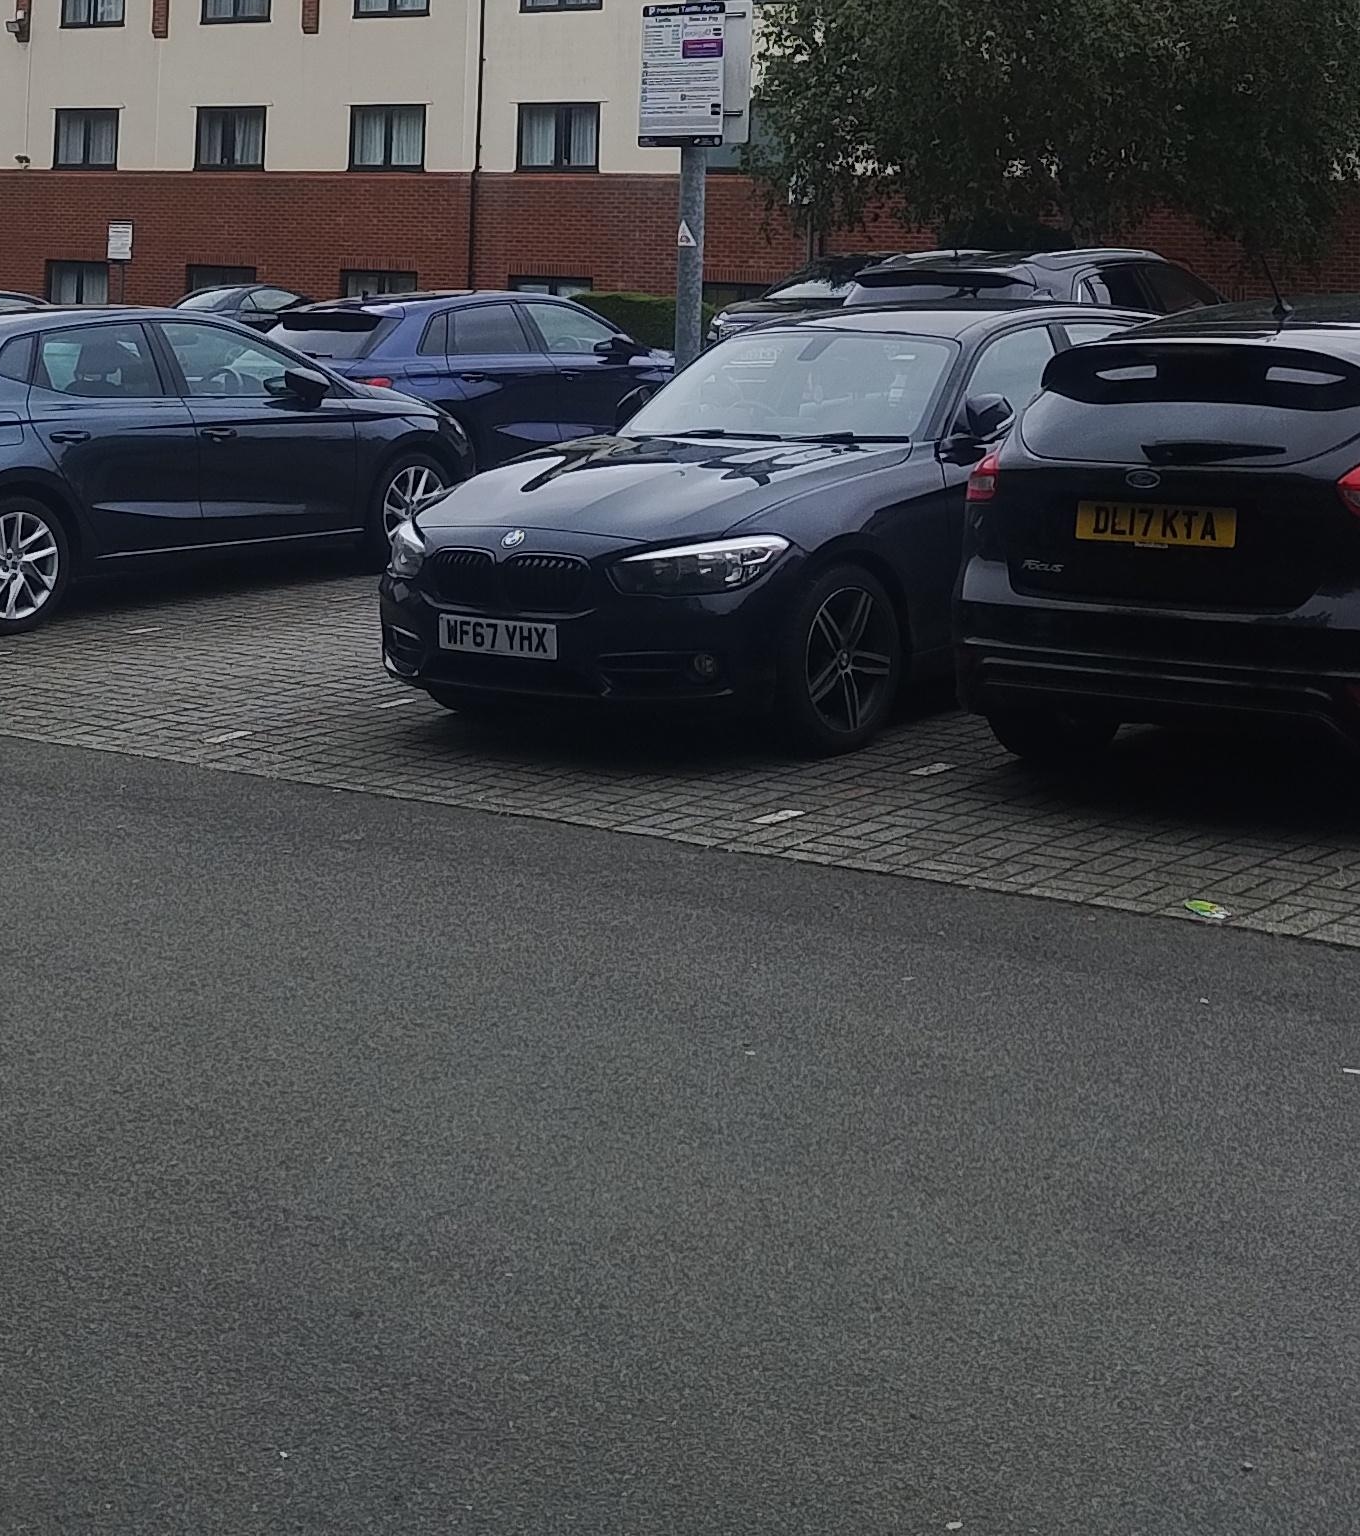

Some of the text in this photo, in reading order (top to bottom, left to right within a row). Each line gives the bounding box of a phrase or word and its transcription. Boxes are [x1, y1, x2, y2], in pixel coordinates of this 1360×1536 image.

[1093, 506, 1217, 541] DL17 KTA
[446, 618, 548, 653] WF67 YHX
